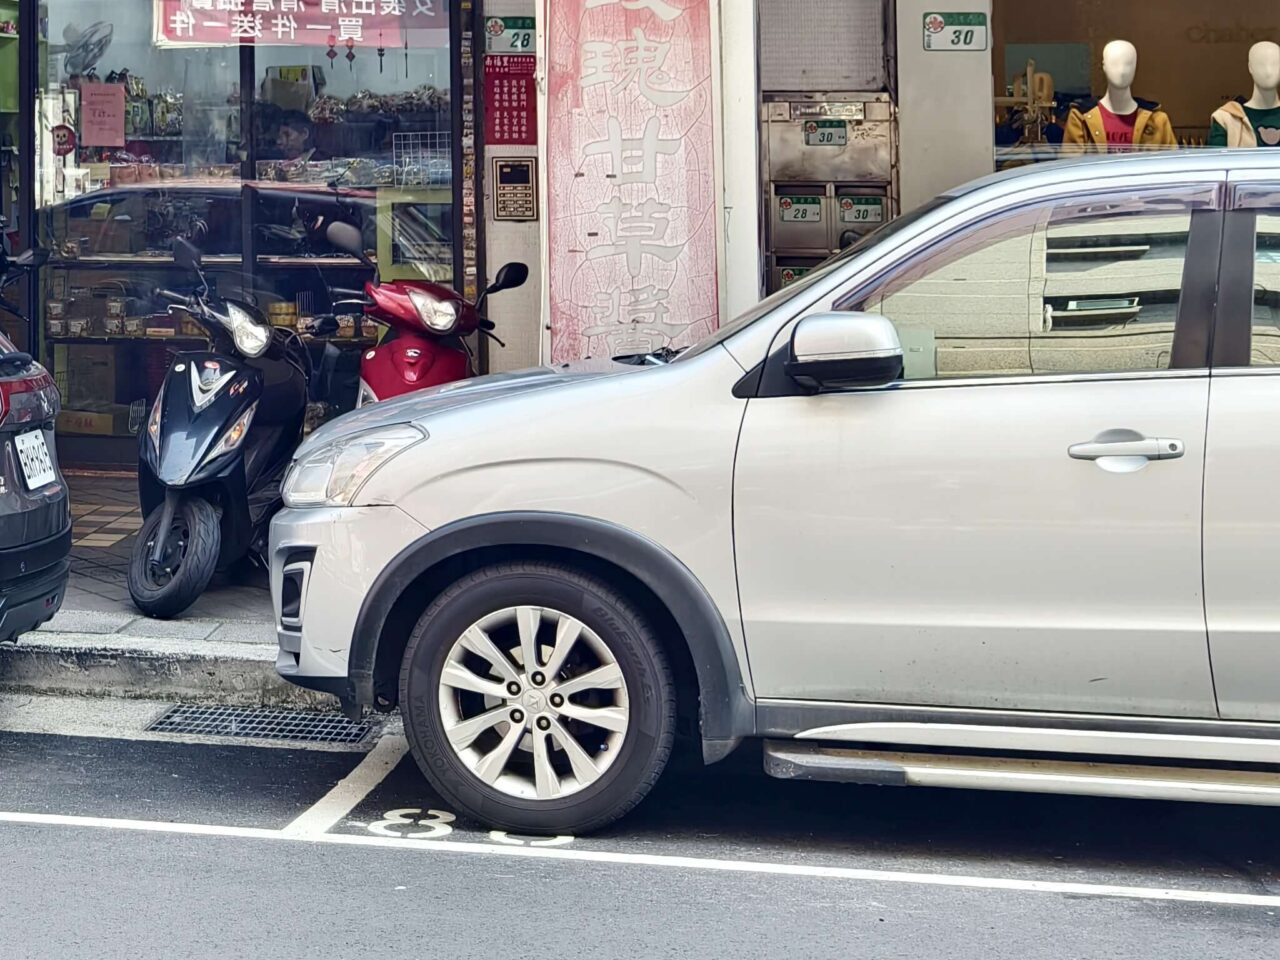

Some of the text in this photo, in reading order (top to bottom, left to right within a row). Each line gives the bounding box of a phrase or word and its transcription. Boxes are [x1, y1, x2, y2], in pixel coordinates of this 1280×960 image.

[510, 32, 531, 49] 28
[951, 29, 974, 46] 30
[818, 132, 833, 143] 30
[793, 208, 869, 220] 28 30
